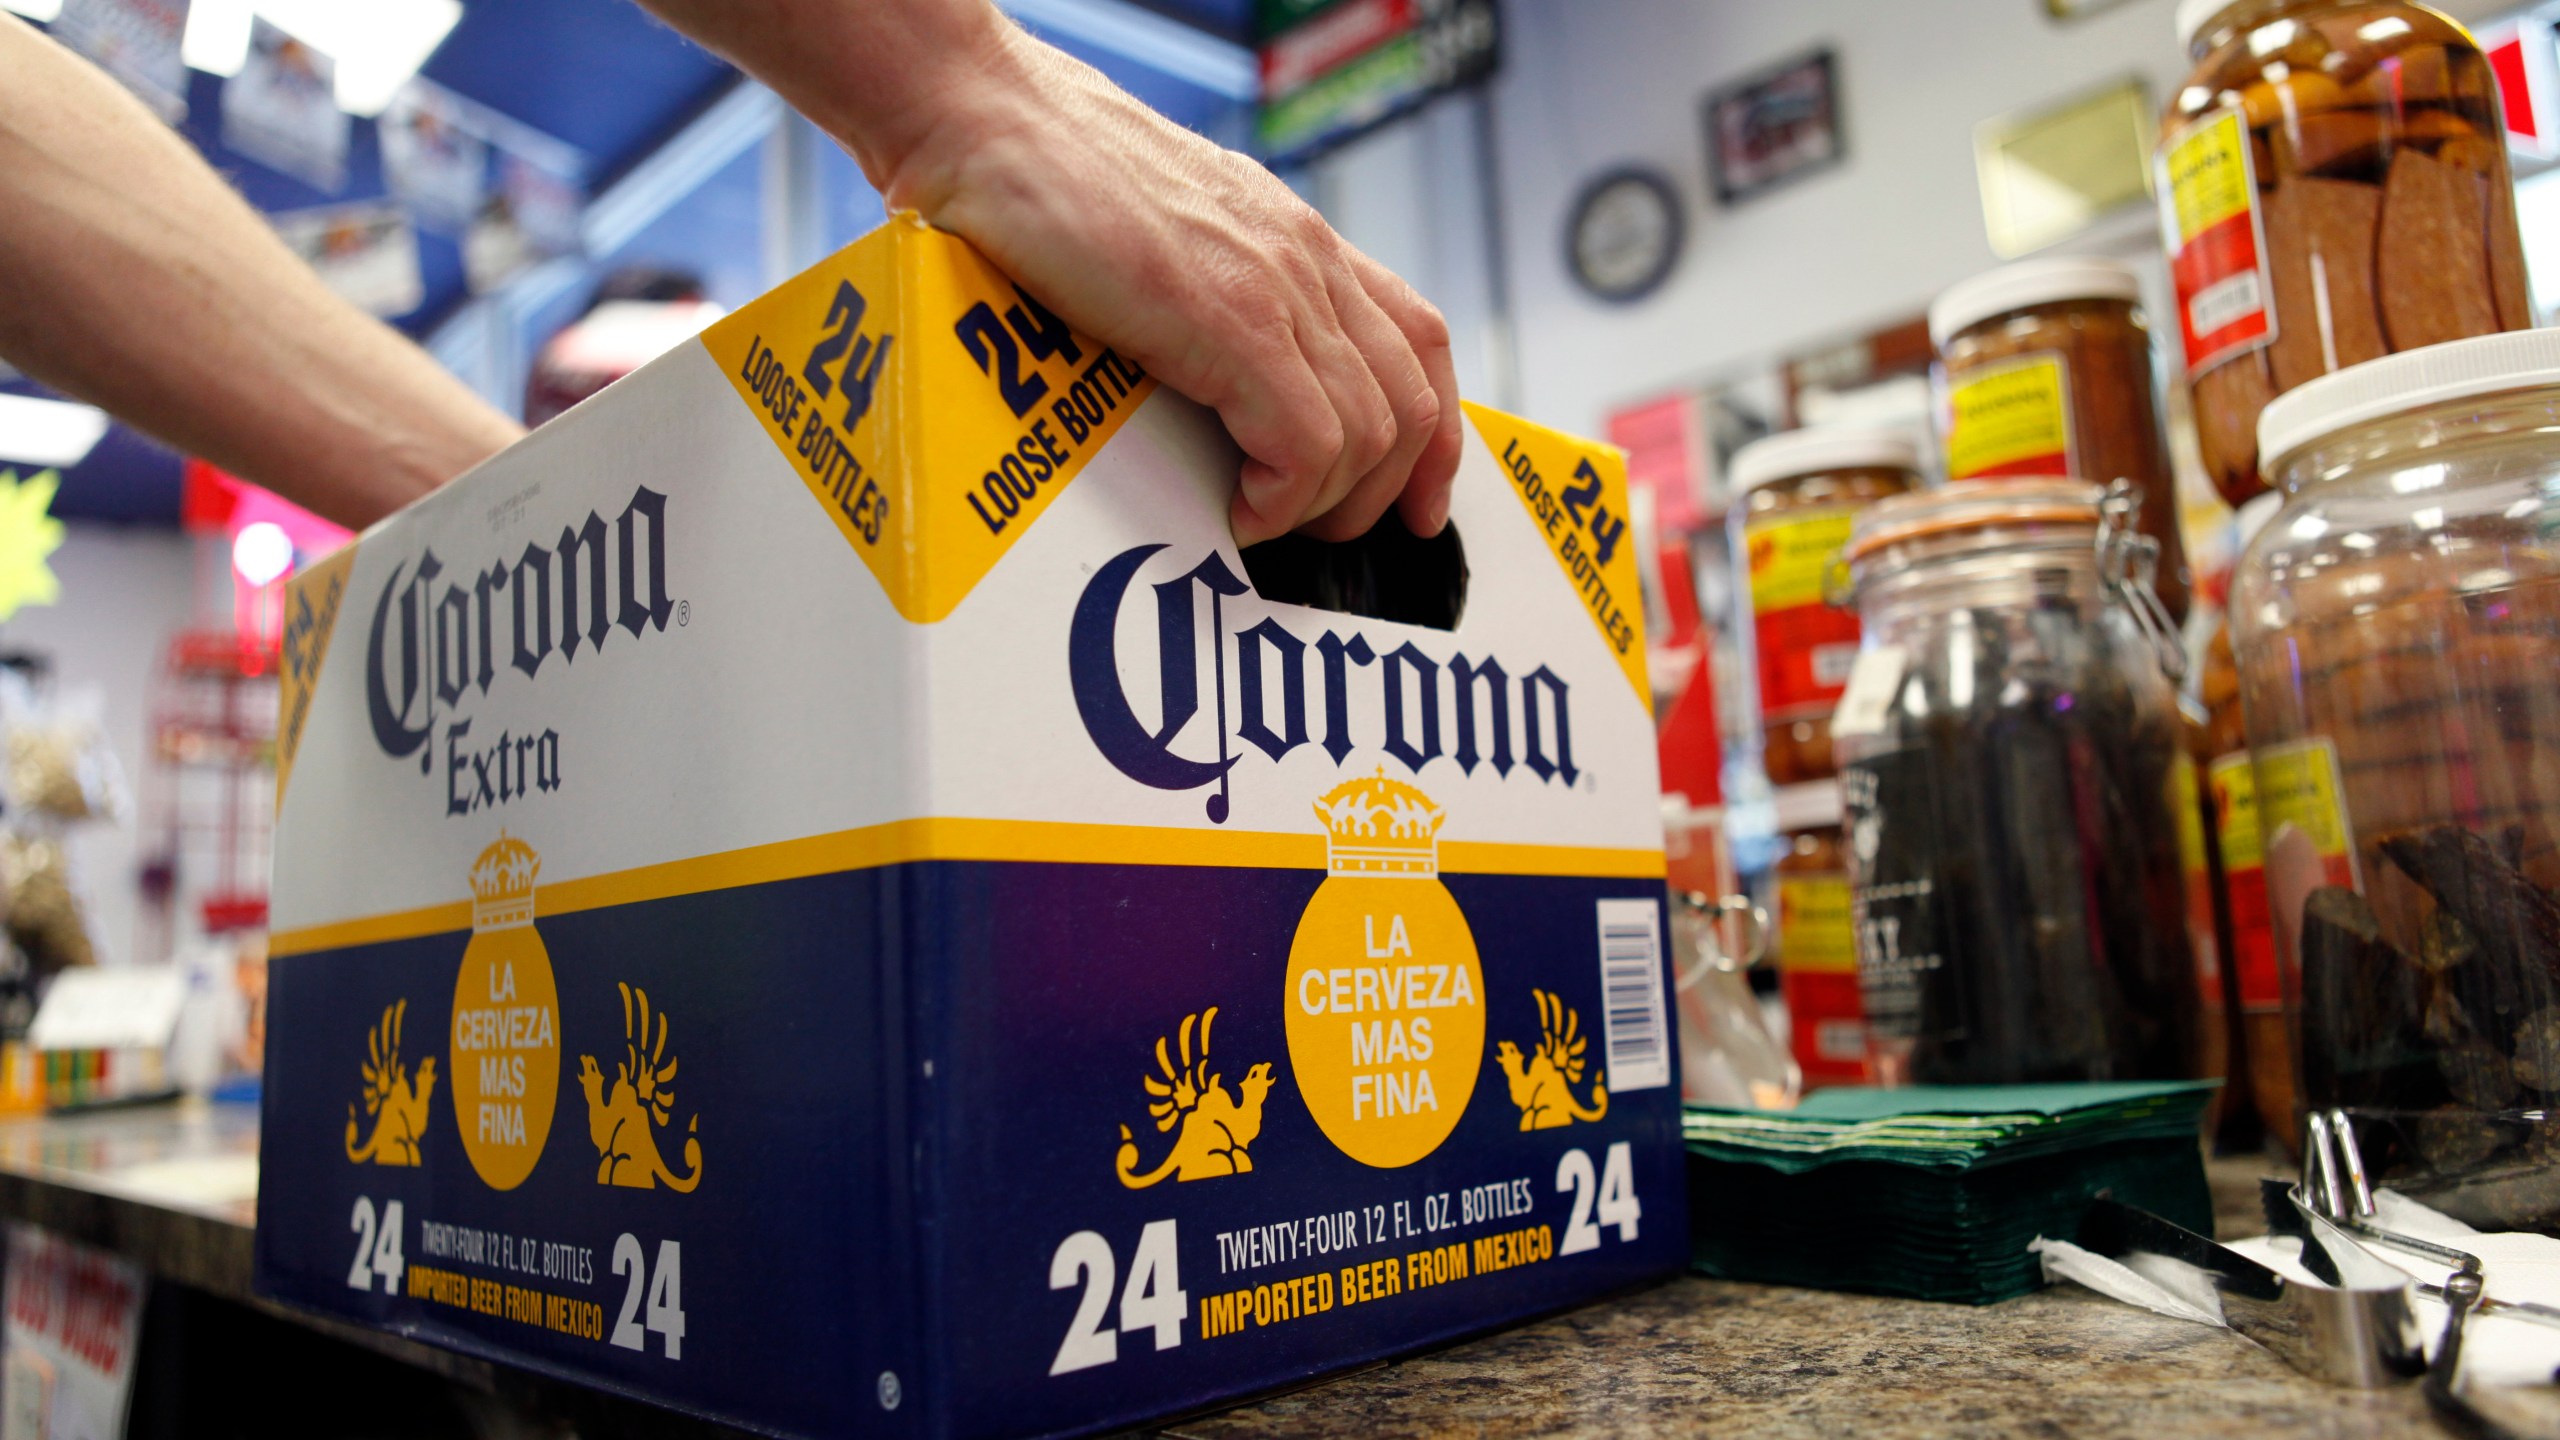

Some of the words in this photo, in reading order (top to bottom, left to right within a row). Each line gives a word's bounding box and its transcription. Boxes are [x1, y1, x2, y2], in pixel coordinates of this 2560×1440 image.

[803, 279, 894, 436] 24
[954, 281, 1083, 420] 24
[741, 334, 807, 439] LOOSE
[797, 408, 889, 546] BOTTLES
[966, 417, 1071, 536] LOOSE
[1051, 346, 1147, 446] BOTTL
[1502, 438, 1565, 539] LOOSE
[1560, 531, 1634, 656] BOTTLES
[1560, 457, 1625, 569] 24
[366, 484, 675, 776] Corona
[1069, 543, 1580, 825] Corona
[446, 717, 562, 818] Extra
[489, 960, 516, 1003] LA
[1364, 914, 1412, 958] LA
[456, 1005, 554, 1051] CERVEZA
[1299, 964, 1475, 1015] CERVEZA
[479, 1054, 526, 1098] MAS
[1350, 1018, 1434, 1066] MAS
[478, 1103, 527, 1146] FINA
[1352, 1069, 1438, 1121] FINA
[346, 1195, 404, 1297] 24
[1216, 1210, 1358, 1274] TWENTY-FOUR
[1363, 1205, 1387, 1245] 12
[1393, 1200, 1422, 1239] FL.
[1424, 1193, 1457, 1232] OZ.
[1461, 1177, 1534, 1226] BOTTLES
[1556, 1142, 1641, 1257] 24
[408, 1264, 468, 1310] IMPORTED
[470, 1277, 502, 1318] BEER
[505, 1285, 542, 1327] FROM
[546, 1294, 602, 1342] MEXICO
[422, 1220, 485, 1265] TWENTY-FOUR
[487, 1231, 500, 1268] 12
[503, 1234, 519, 1272] FL.
[521, 1237, 540, 1275] OZ.
[543, 1241, 593, 1286] BOTTLES
[610, 1232, 686, 1361] 24
[1047, 1218, 1187, 1377] 24
[1200, 1272, 1334, 1340] IMPORTED
[1340, 1257, 1401, 1307] BEER
[1407, 1242, 1469, 1291] FROM
[1474, 1224, 1553, 1276] MEXICO
